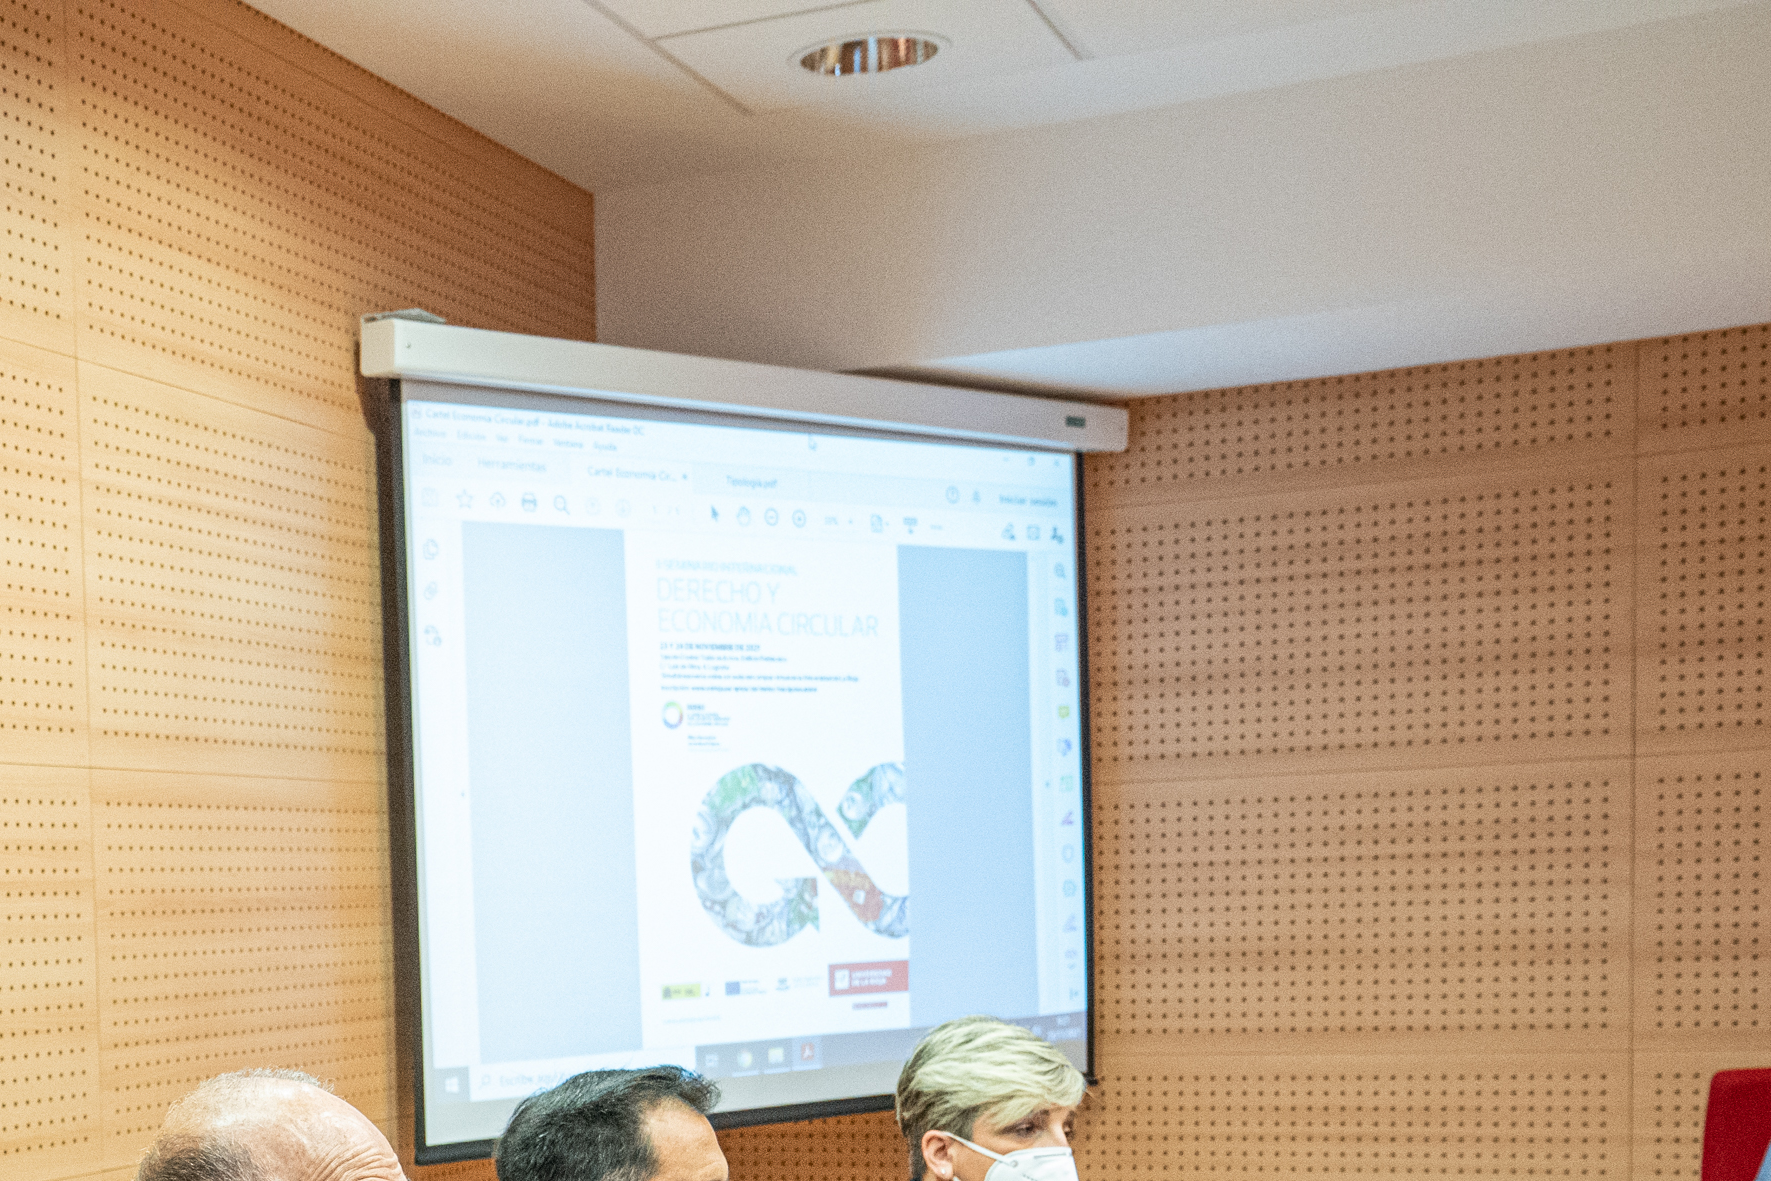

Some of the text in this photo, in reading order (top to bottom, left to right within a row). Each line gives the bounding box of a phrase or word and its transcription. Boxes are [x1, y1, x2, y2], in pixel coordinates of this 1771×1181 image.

[422, 453, 453, 466] Inicio
[477, 456, 547, 472] Herramientas
[656, 576, 780, 605] DERECHO Y
[776, 611, 879, 638] CIRCULAR
